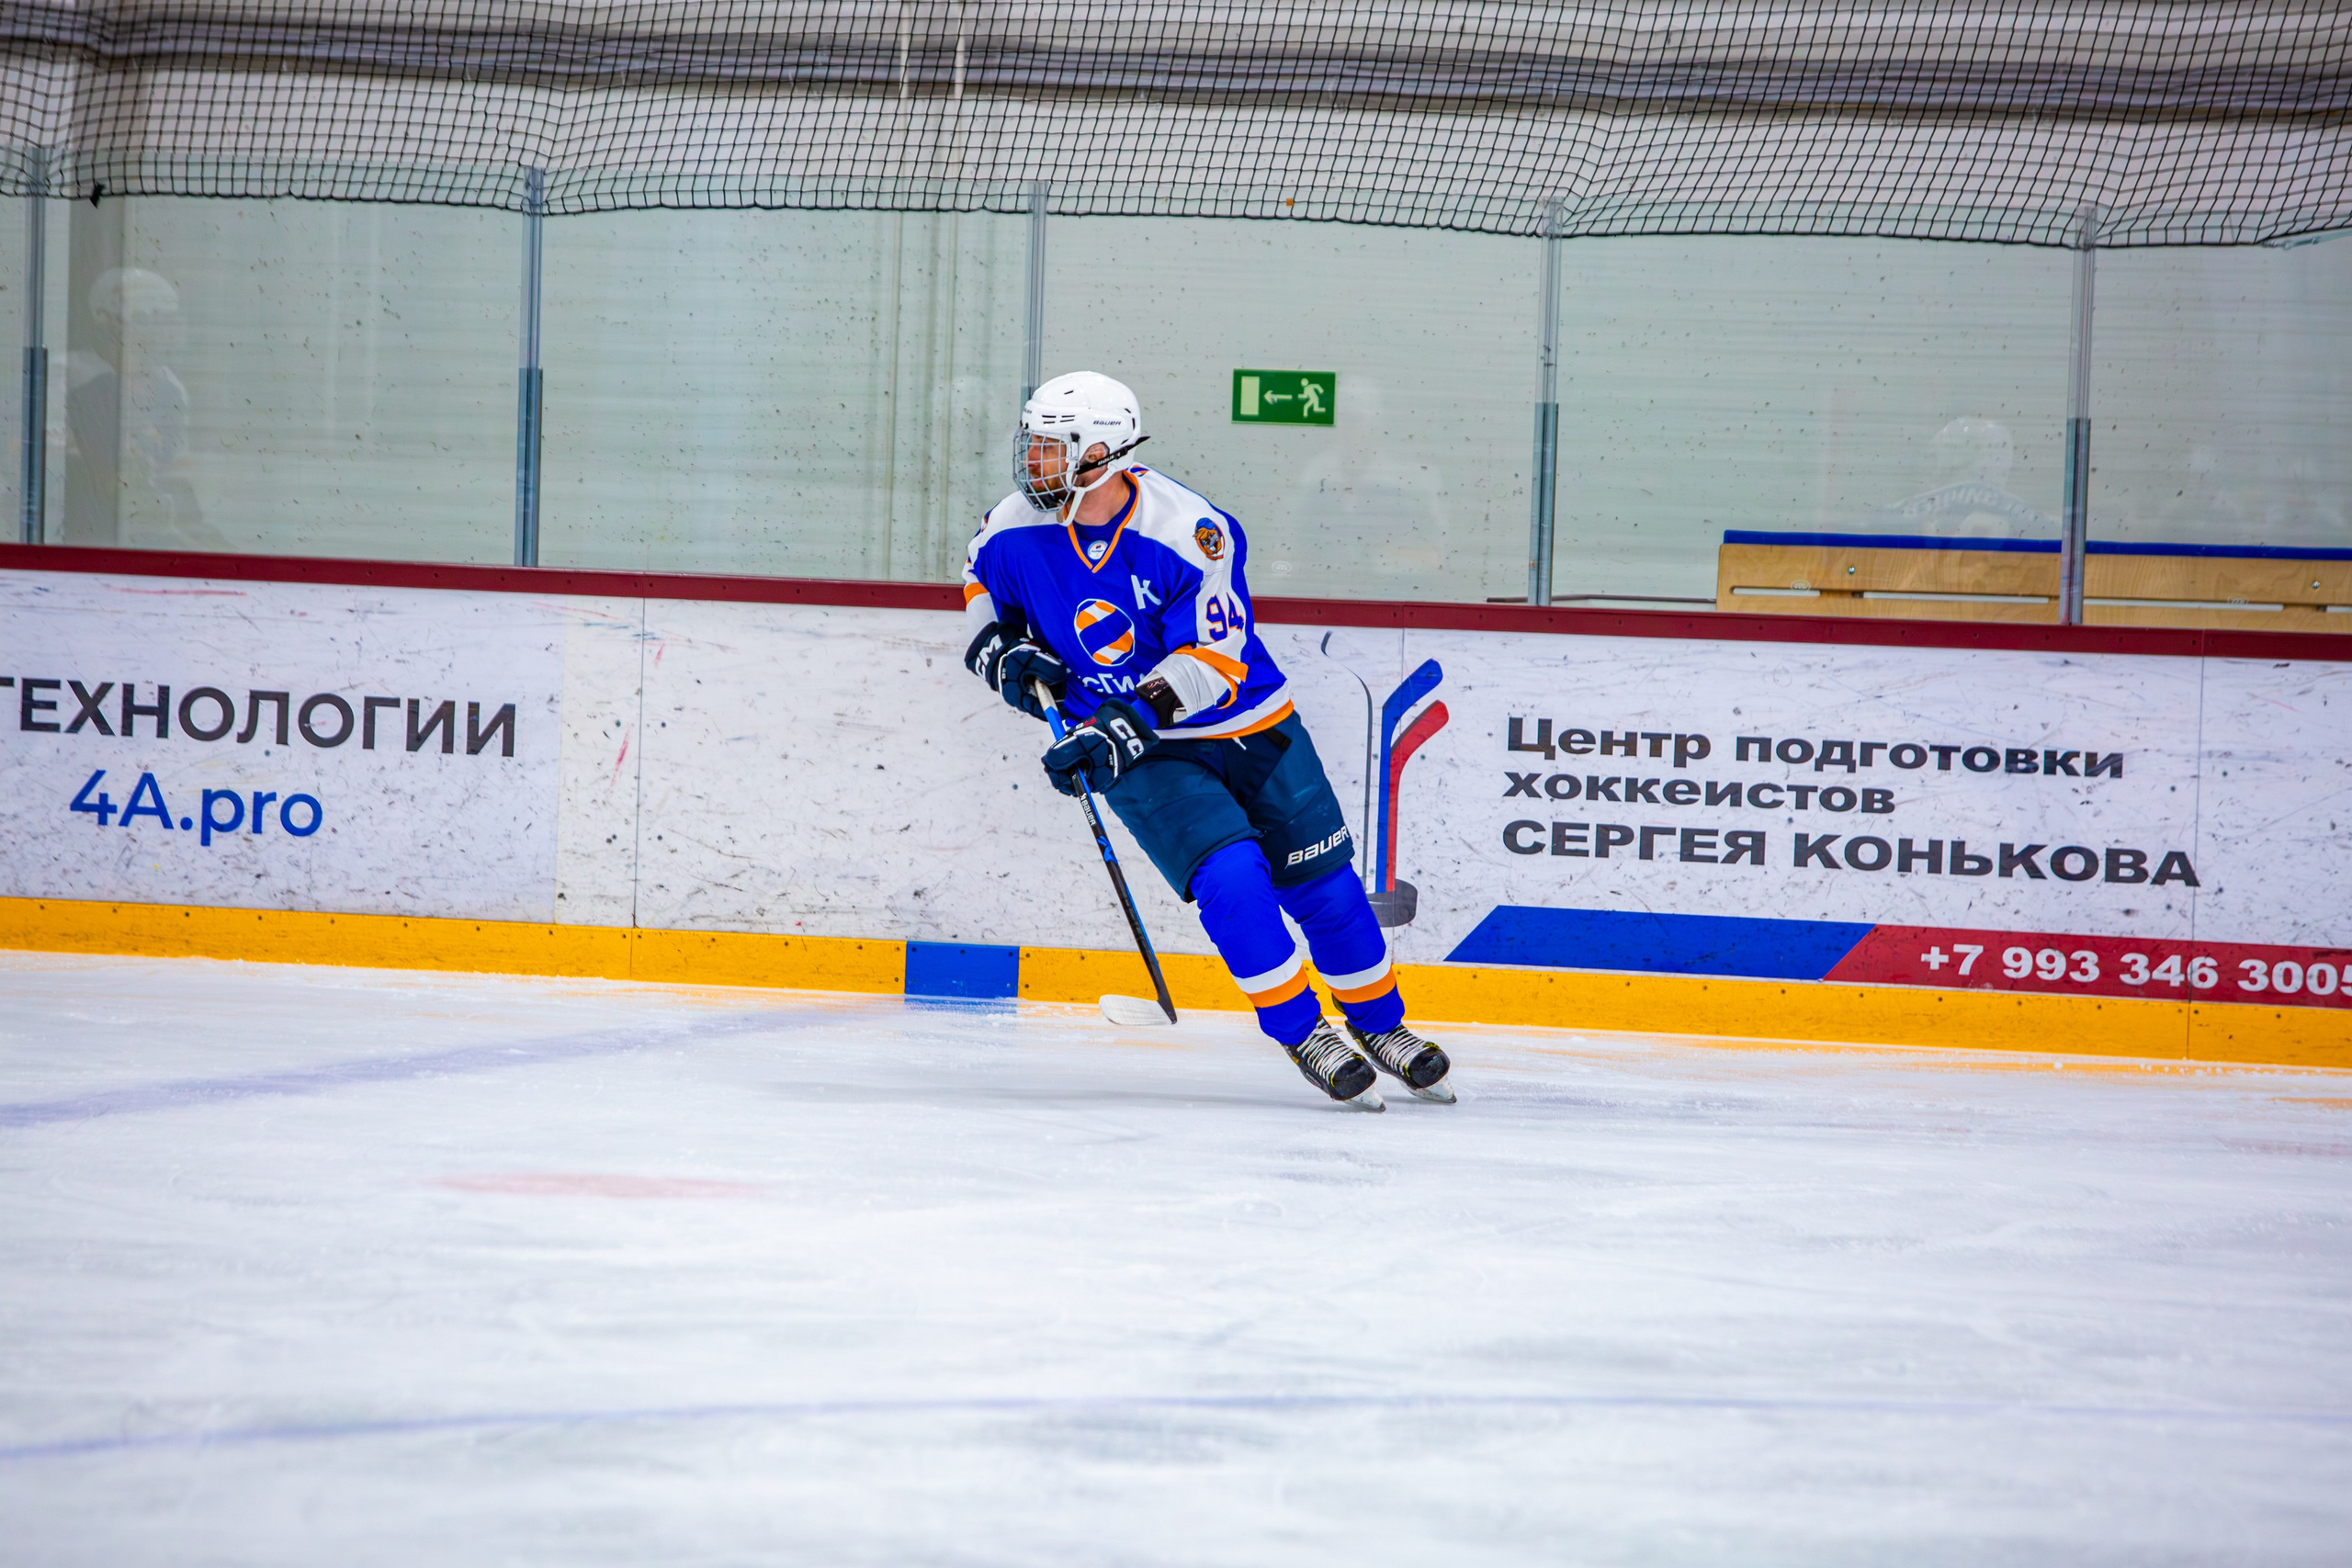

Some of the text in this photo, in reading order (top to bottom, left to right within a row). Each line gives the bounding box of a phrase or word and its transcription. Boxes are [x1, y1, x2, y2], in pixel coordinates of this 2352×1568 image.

[1206, 592, 1245, 643] 94
[1508, 716, 2123, 779] Центр подготовки
[69, 769, 323, 848] 4A.pro
[1501, 772, 1895, 814] хоккеистов
[1285, 825, 1350, 868] BAUER
[1502, 819, 2202, 888] СЕРГЕЯ КОНЬКОВА
[1920, 943, 1984, 976] +7
[2002, 946, 2100, 983] 993
[2119, 953, 2219, 989] 346
